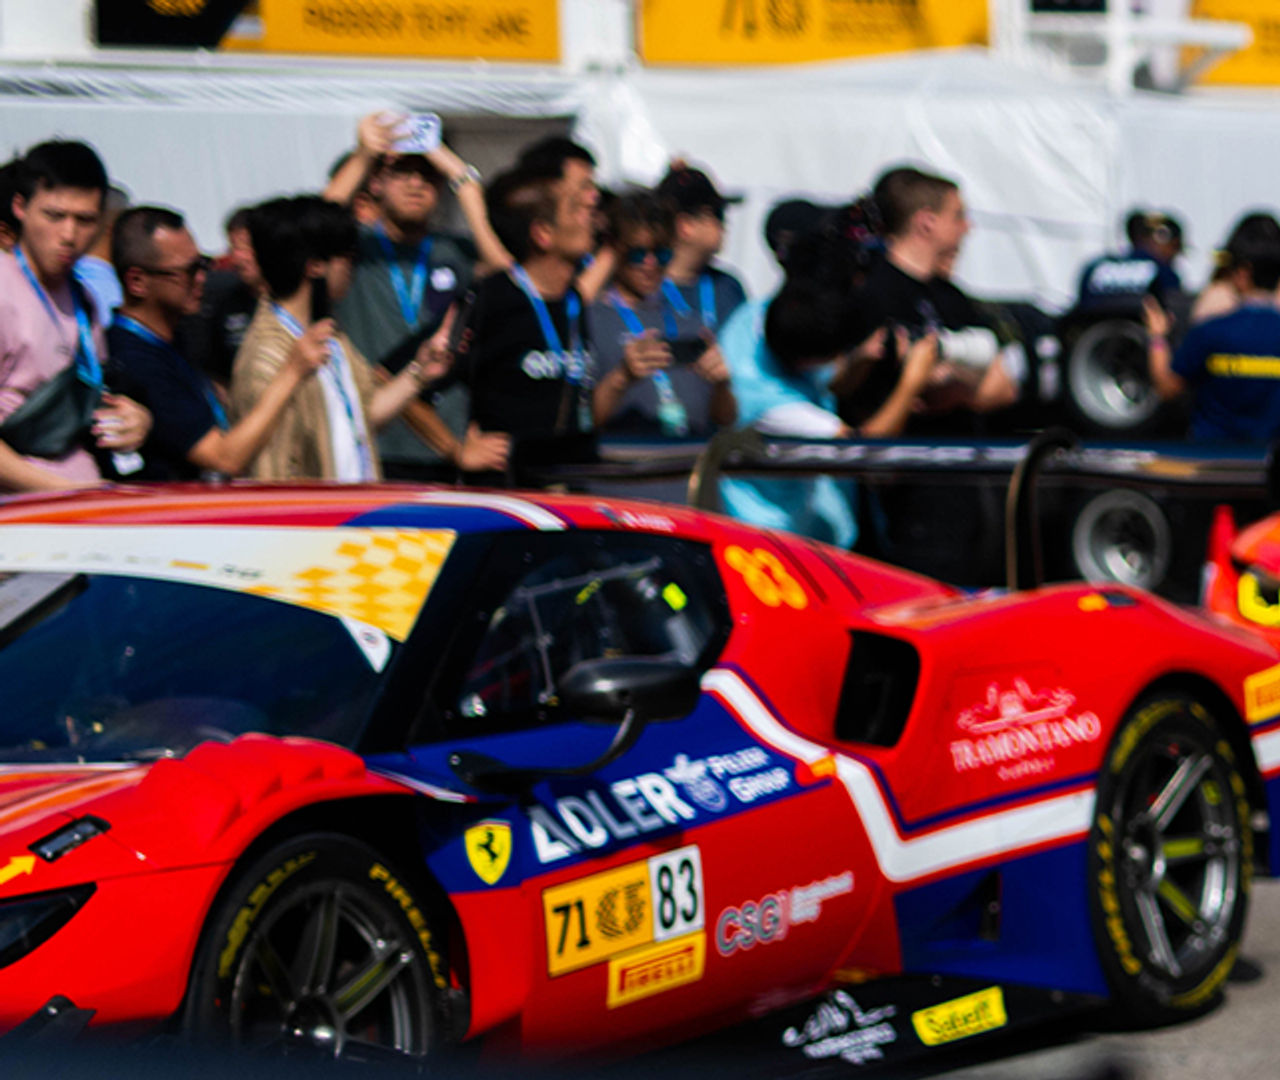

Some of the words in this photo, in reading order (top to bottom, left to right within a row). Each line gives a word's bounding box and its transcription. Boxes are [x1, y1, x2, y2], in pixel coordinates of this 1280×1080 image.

[724, 544, 808, 611] 83
[950, 711, 1102, 773] TRAMONTANO
[530, 772, 697, 864] ADLER
[370, 862, 449, 990] PIRELLI
[656, 858, 699, 930] 83
[552, 900, 591, 956] 71
[618, 945, 697, 994] PIRELLI
